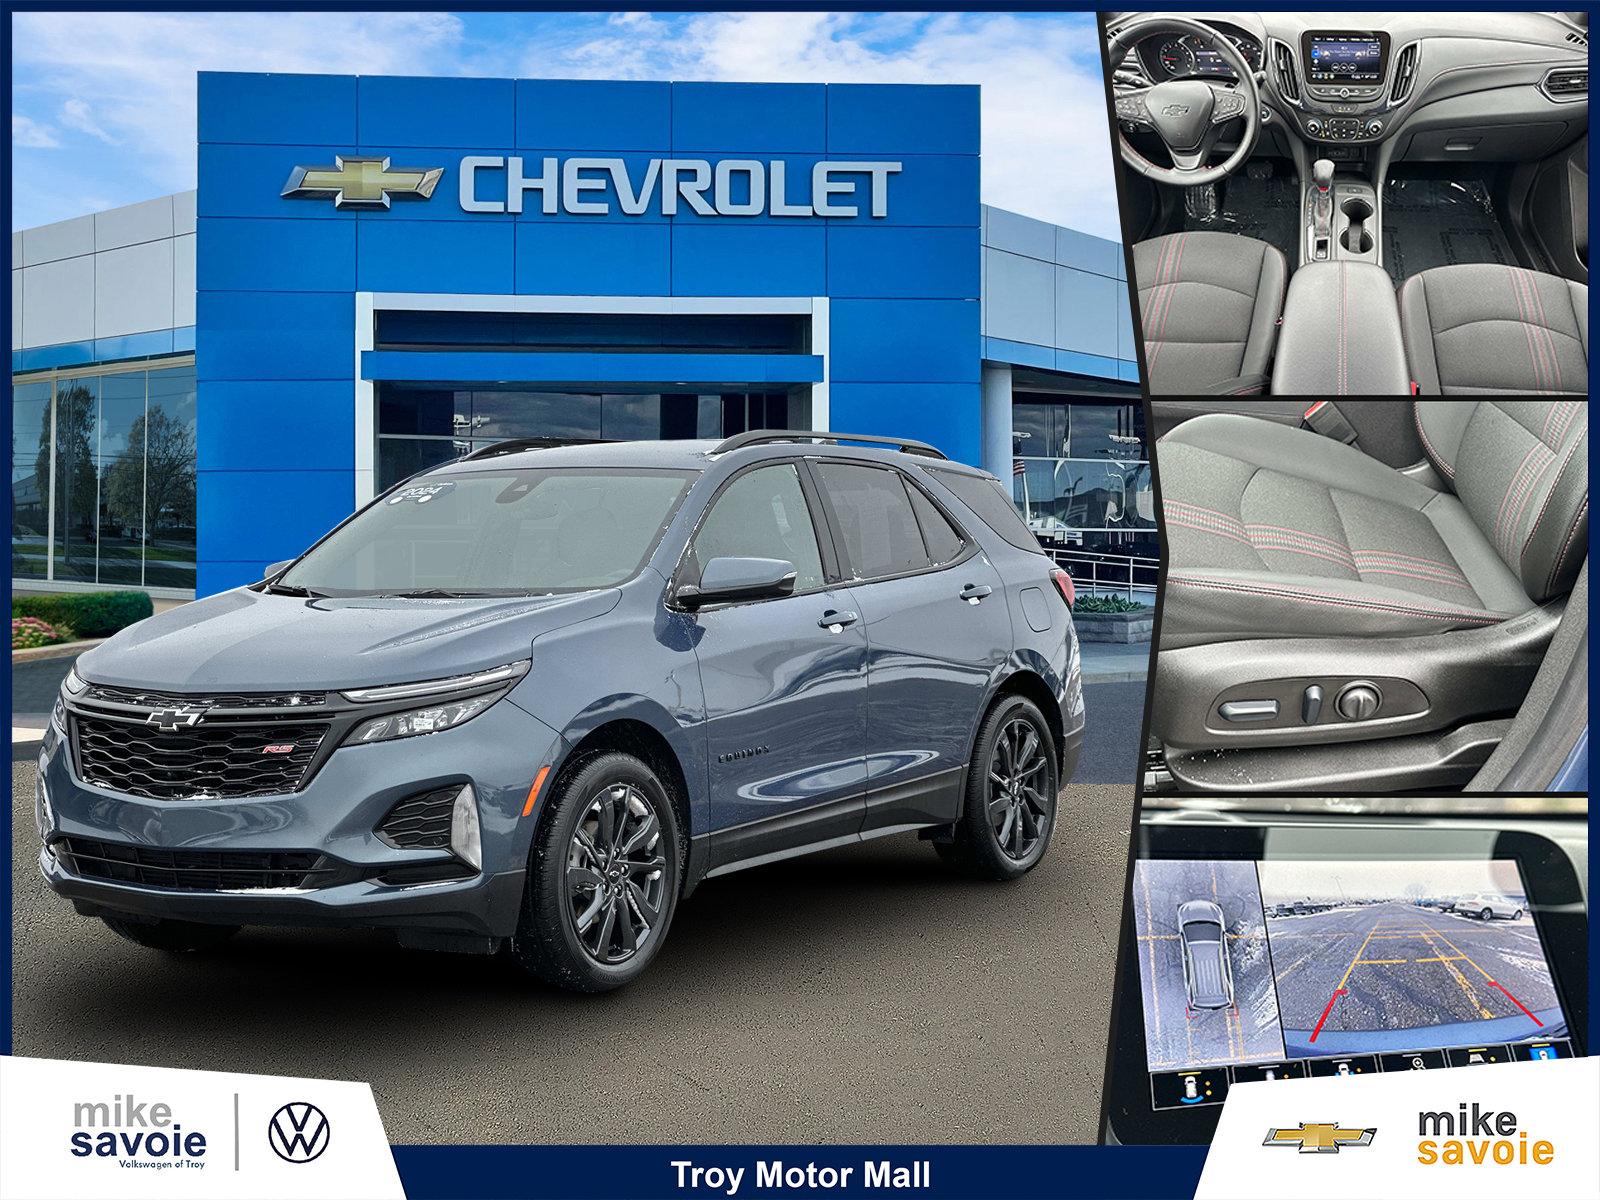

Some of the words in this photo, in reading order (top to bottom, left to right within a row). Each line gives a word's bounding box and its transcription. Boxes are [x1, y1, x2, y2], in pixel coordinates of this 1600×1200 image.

[459, 156, 902, 217] CHEVROLET
[401, 487, 443, 497] 2024
[262, 745, 294, 754] RS
[718, 744, 770, 763] EQUINOX
